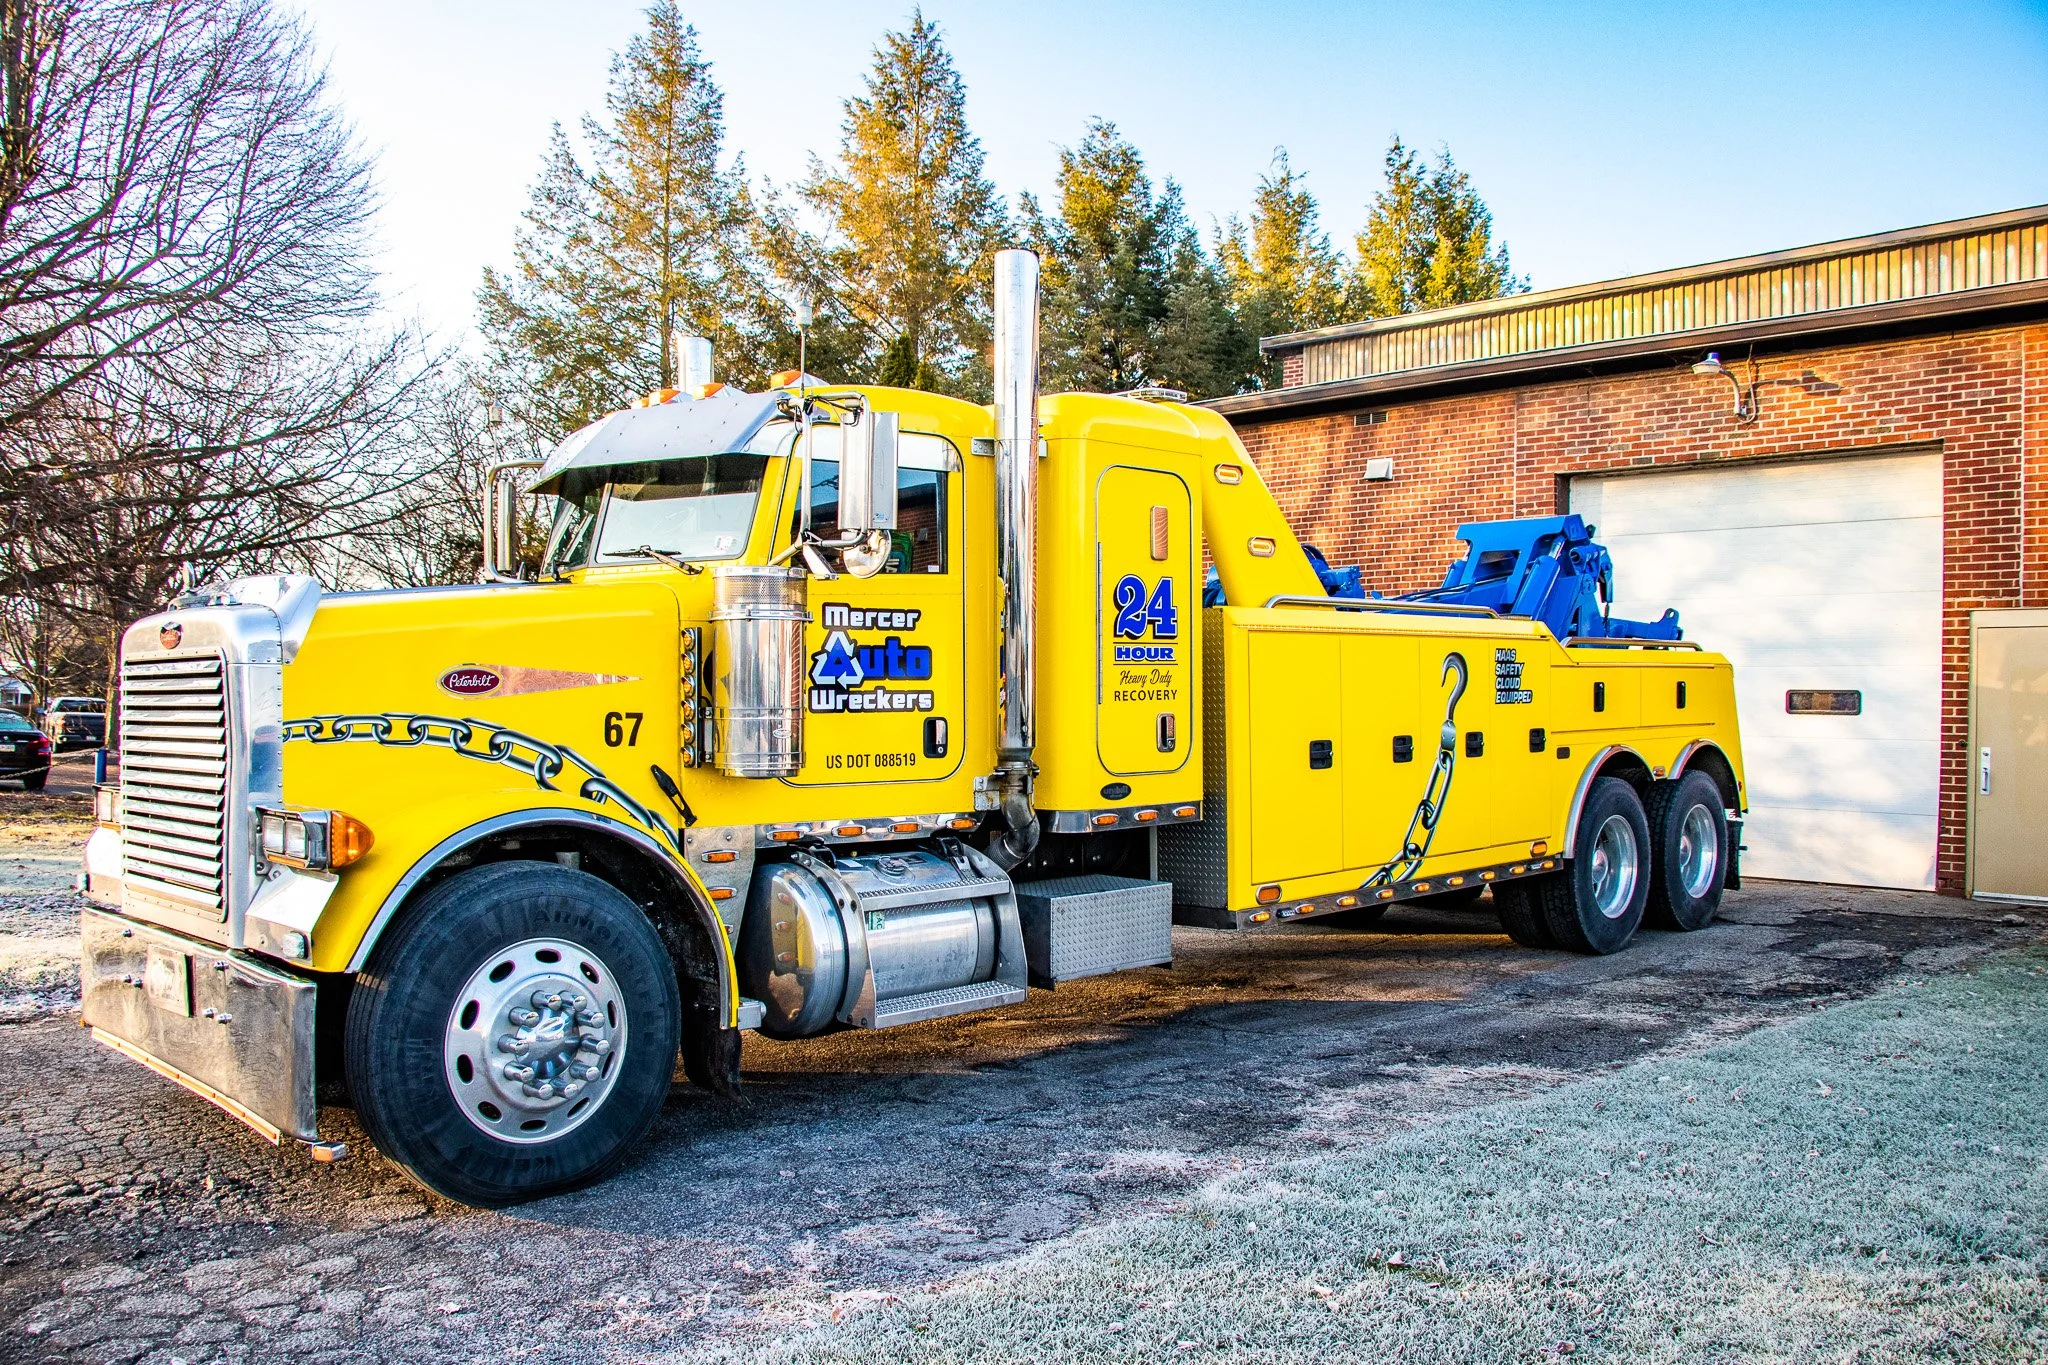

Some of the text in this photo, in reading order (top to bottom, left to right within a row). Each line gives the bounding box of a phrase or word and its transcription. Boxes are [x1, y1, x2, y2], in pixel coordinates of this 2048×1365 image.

[1113, 574, 1177, 639] 24
[823, 603, 920, 629] Mercer
[816, 635, 931, 679] Auto
[1114, 645, 1176, 661] HOUR
[1495, 648, 1516, 662] HAAS
[1495, 662, 1524, 676] SAFETY
[449, 673, 496, 688] Peterbilt
[1120, 669, 1172, 688] Heavy Duty
[1495, 677, 1521, 690] CLOUD
[810, 688, 933, 712] Wreckers
[1114, 690, 1177, 701] RECOVERY
[1495, 690, 1533, 704] EQUIPPED
[604, 711, 644, 747] 67
[826, 753, 916, 769] US DOT 088519
